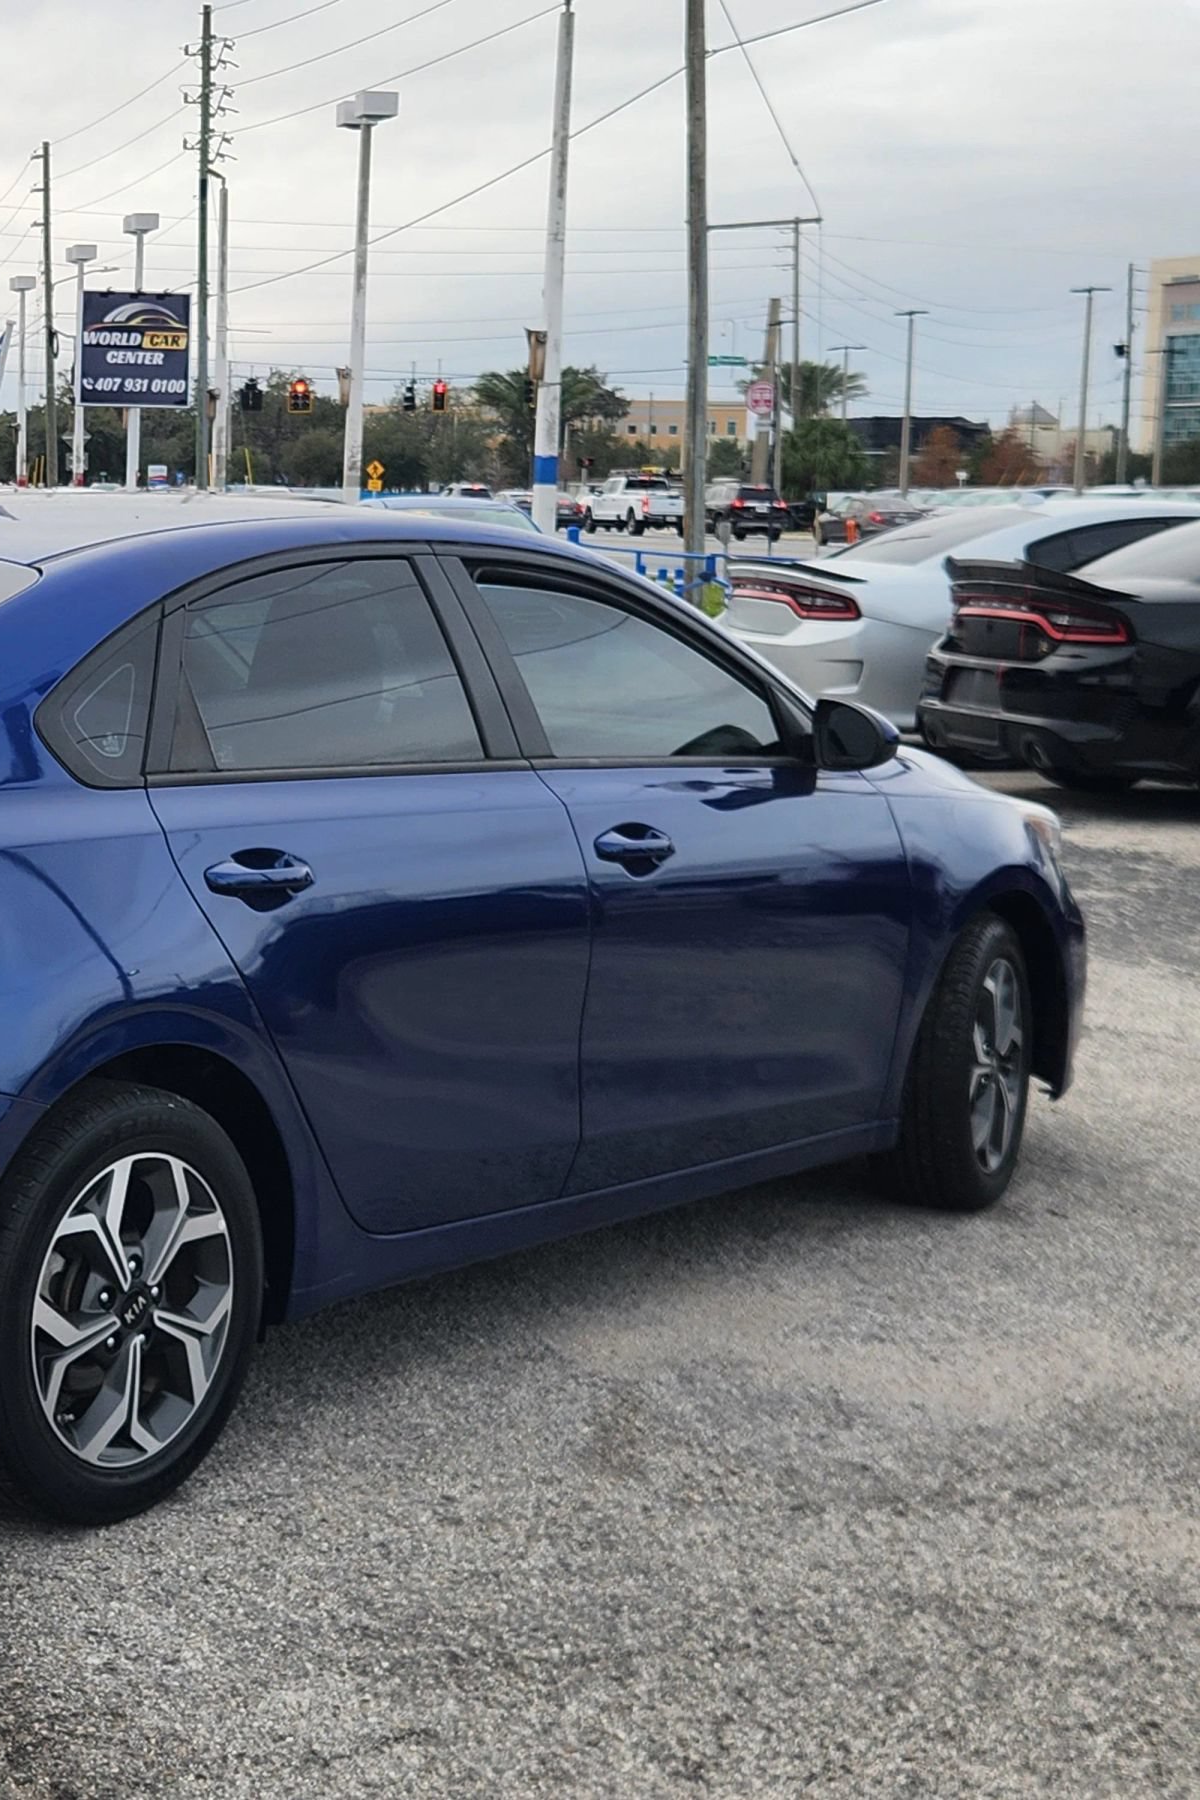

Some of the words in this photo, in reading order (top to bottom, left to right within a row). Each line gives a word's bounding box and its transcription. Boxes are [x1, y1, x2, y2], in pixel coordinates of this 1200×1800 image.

[83, 331, 142, 346] WORLD
[149, 333, 181, 347] CAR
[105, 350, 165, 365] CENTER
[94, 377, 122, 392] 407
[123, 378, 148, 393] 931
[151, 379, 186, 394] 0100
[123, 1295, 147, 1324] KIA
